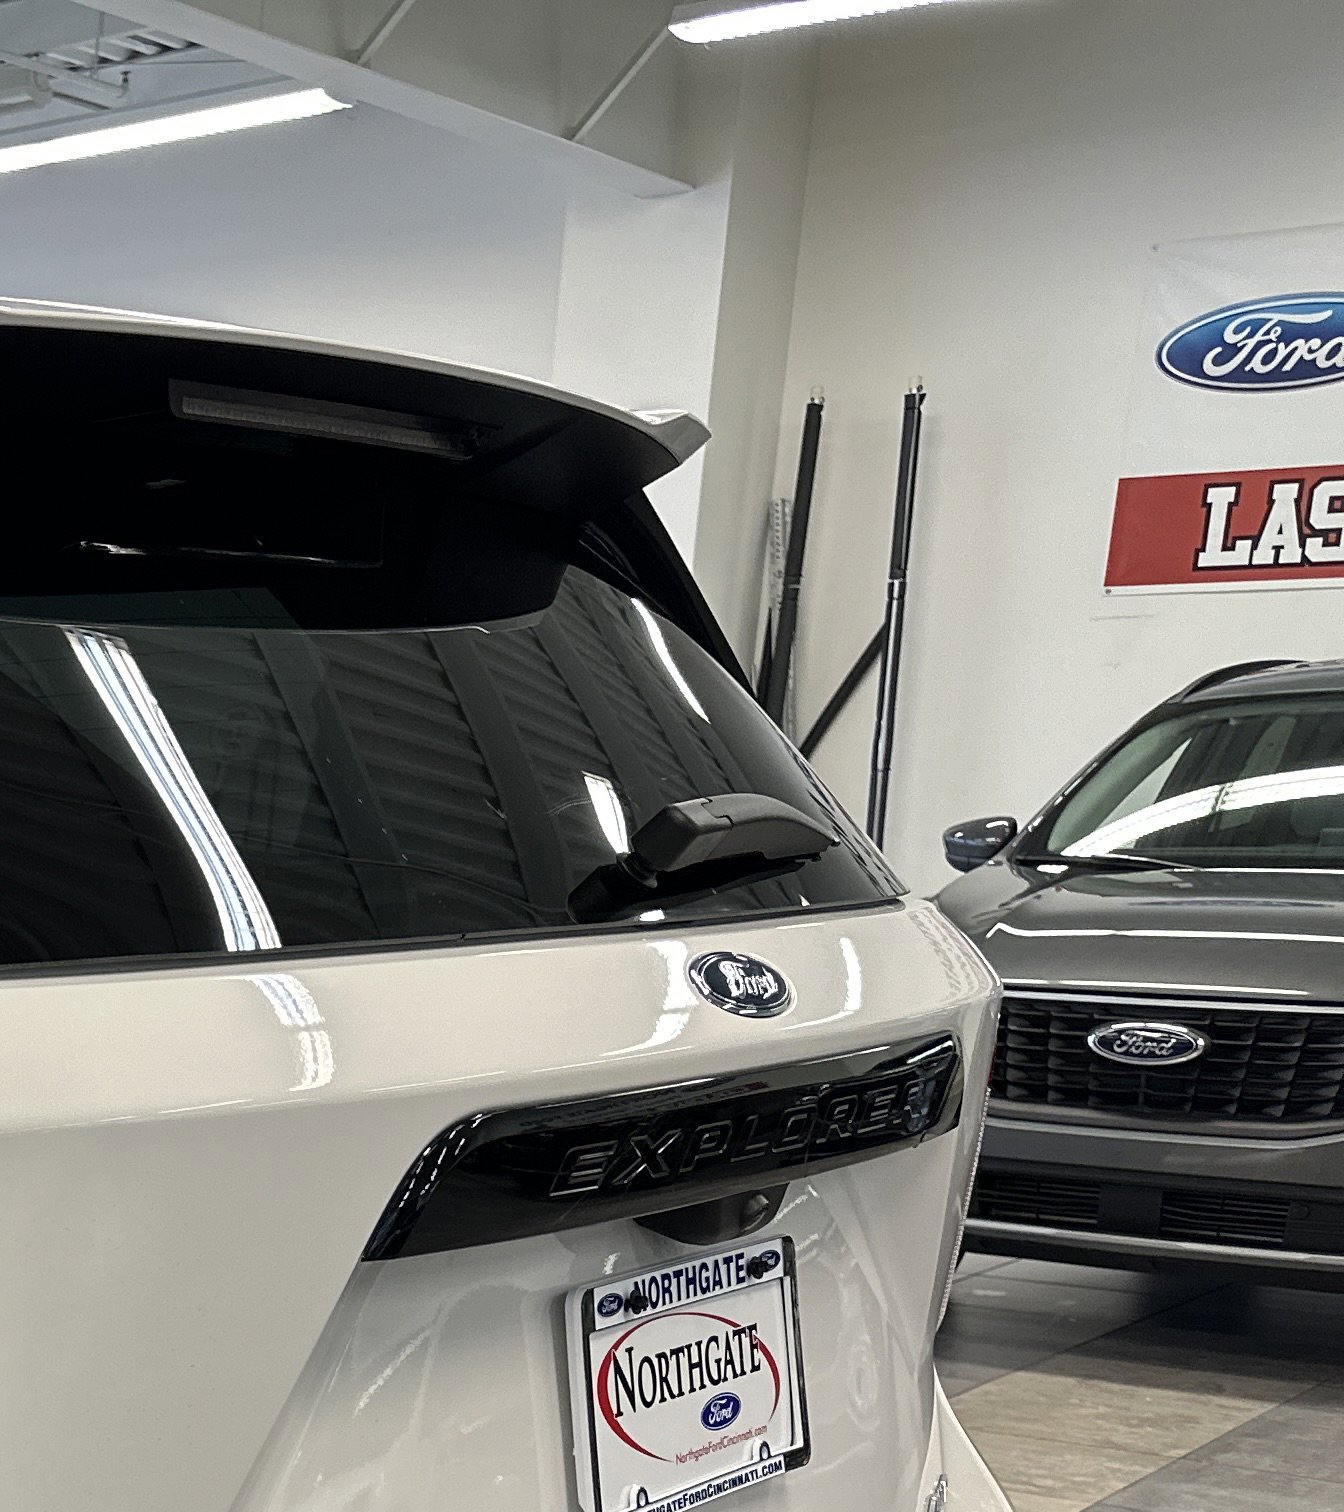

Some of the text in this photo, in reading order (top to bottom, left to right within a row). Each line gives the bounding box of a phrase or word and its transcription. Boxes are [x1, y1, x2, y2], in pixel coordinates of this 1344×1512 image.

[718, 960, 778, 999] Ford
[1113, 1029, 1177, 1056] Ford
[549, 1077, 934, 1197] EXPLORER
[708, 1402, 733, 1424] Ford
